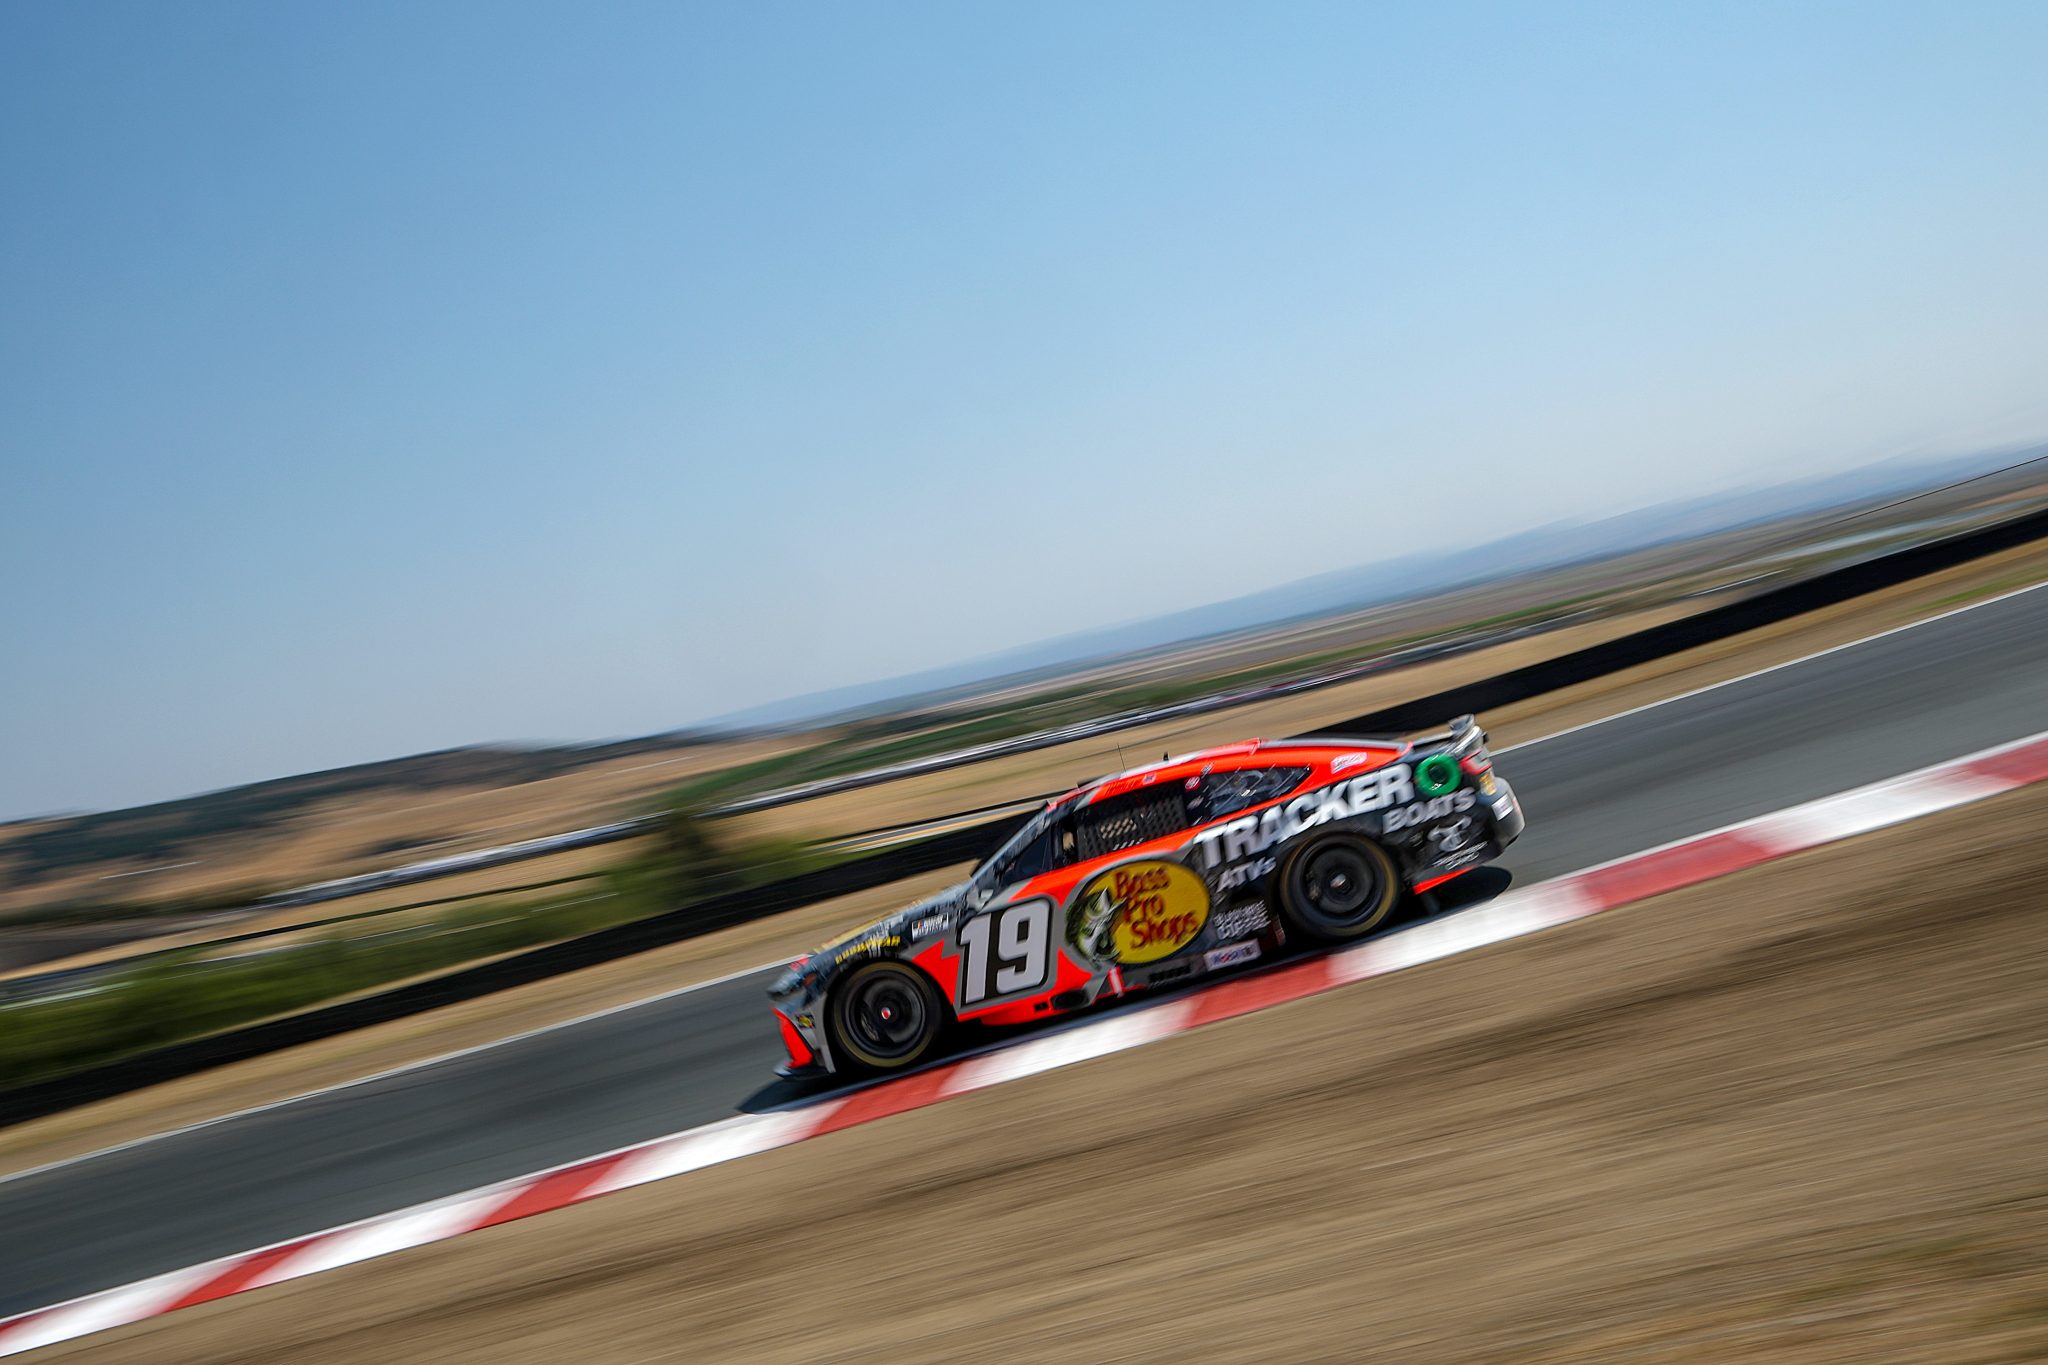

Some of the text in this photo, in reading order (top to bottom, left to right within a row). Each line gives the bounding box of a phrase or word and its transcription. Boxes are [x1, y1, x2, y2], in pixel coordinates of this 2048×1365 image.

[1194, 764, 1415, 869] TRACKER
[1383, 787, 1477, 834] BOATS
[1114, 865, 1171, 900] Bass
[1123, 893, 1165, 922] Pro
[960, 898, 1051, 1004] 19
[1129, 910, 1198, 949] Shops
